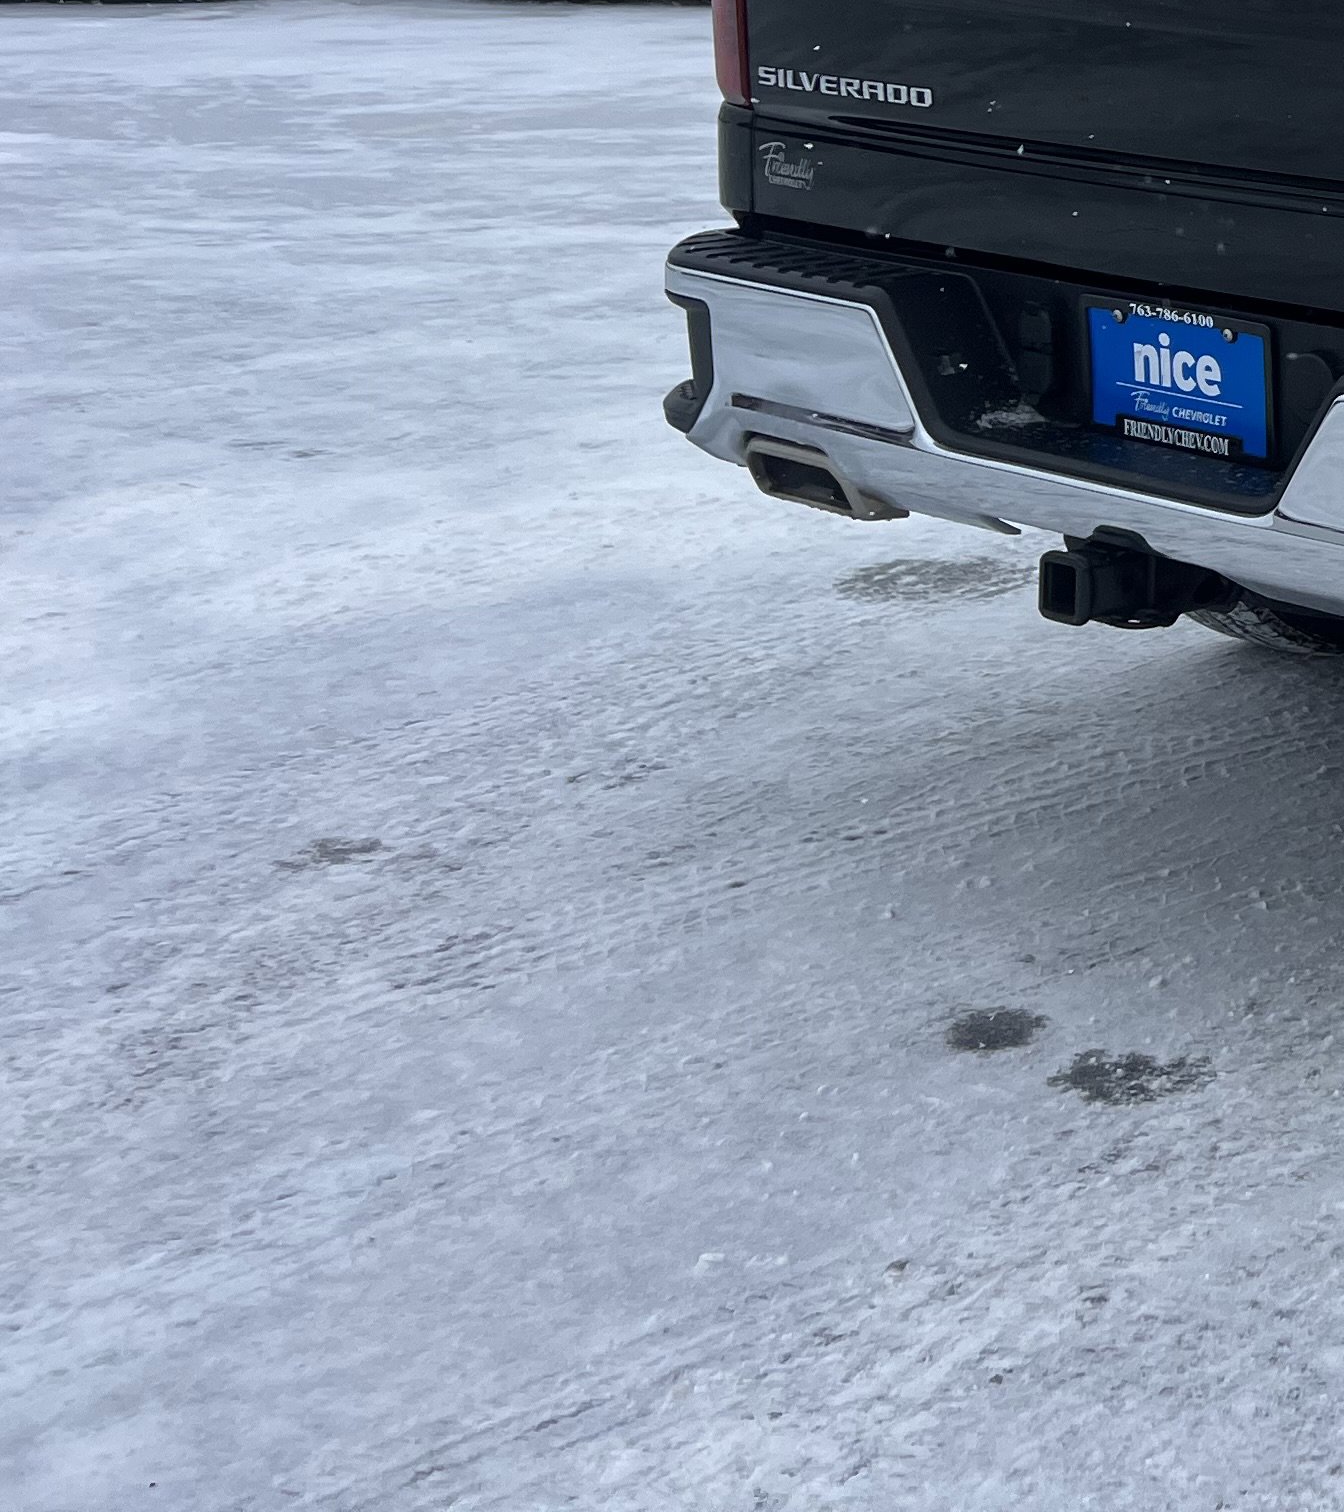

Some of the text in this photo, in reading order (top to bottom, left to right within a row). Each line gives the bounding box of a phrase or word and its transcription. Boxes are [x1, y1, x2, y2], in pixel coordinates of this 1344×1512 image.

[757, 66, 933, 108] SILVERADO
[1129, 303, 1214, 328] 763-786-6100
[1133, 332, 1222, 397] nice
[1172, 406, 1227, 427] CHEVROLET
[1123, 418, 1229, 456] FRIENDLYCHEV.COM
